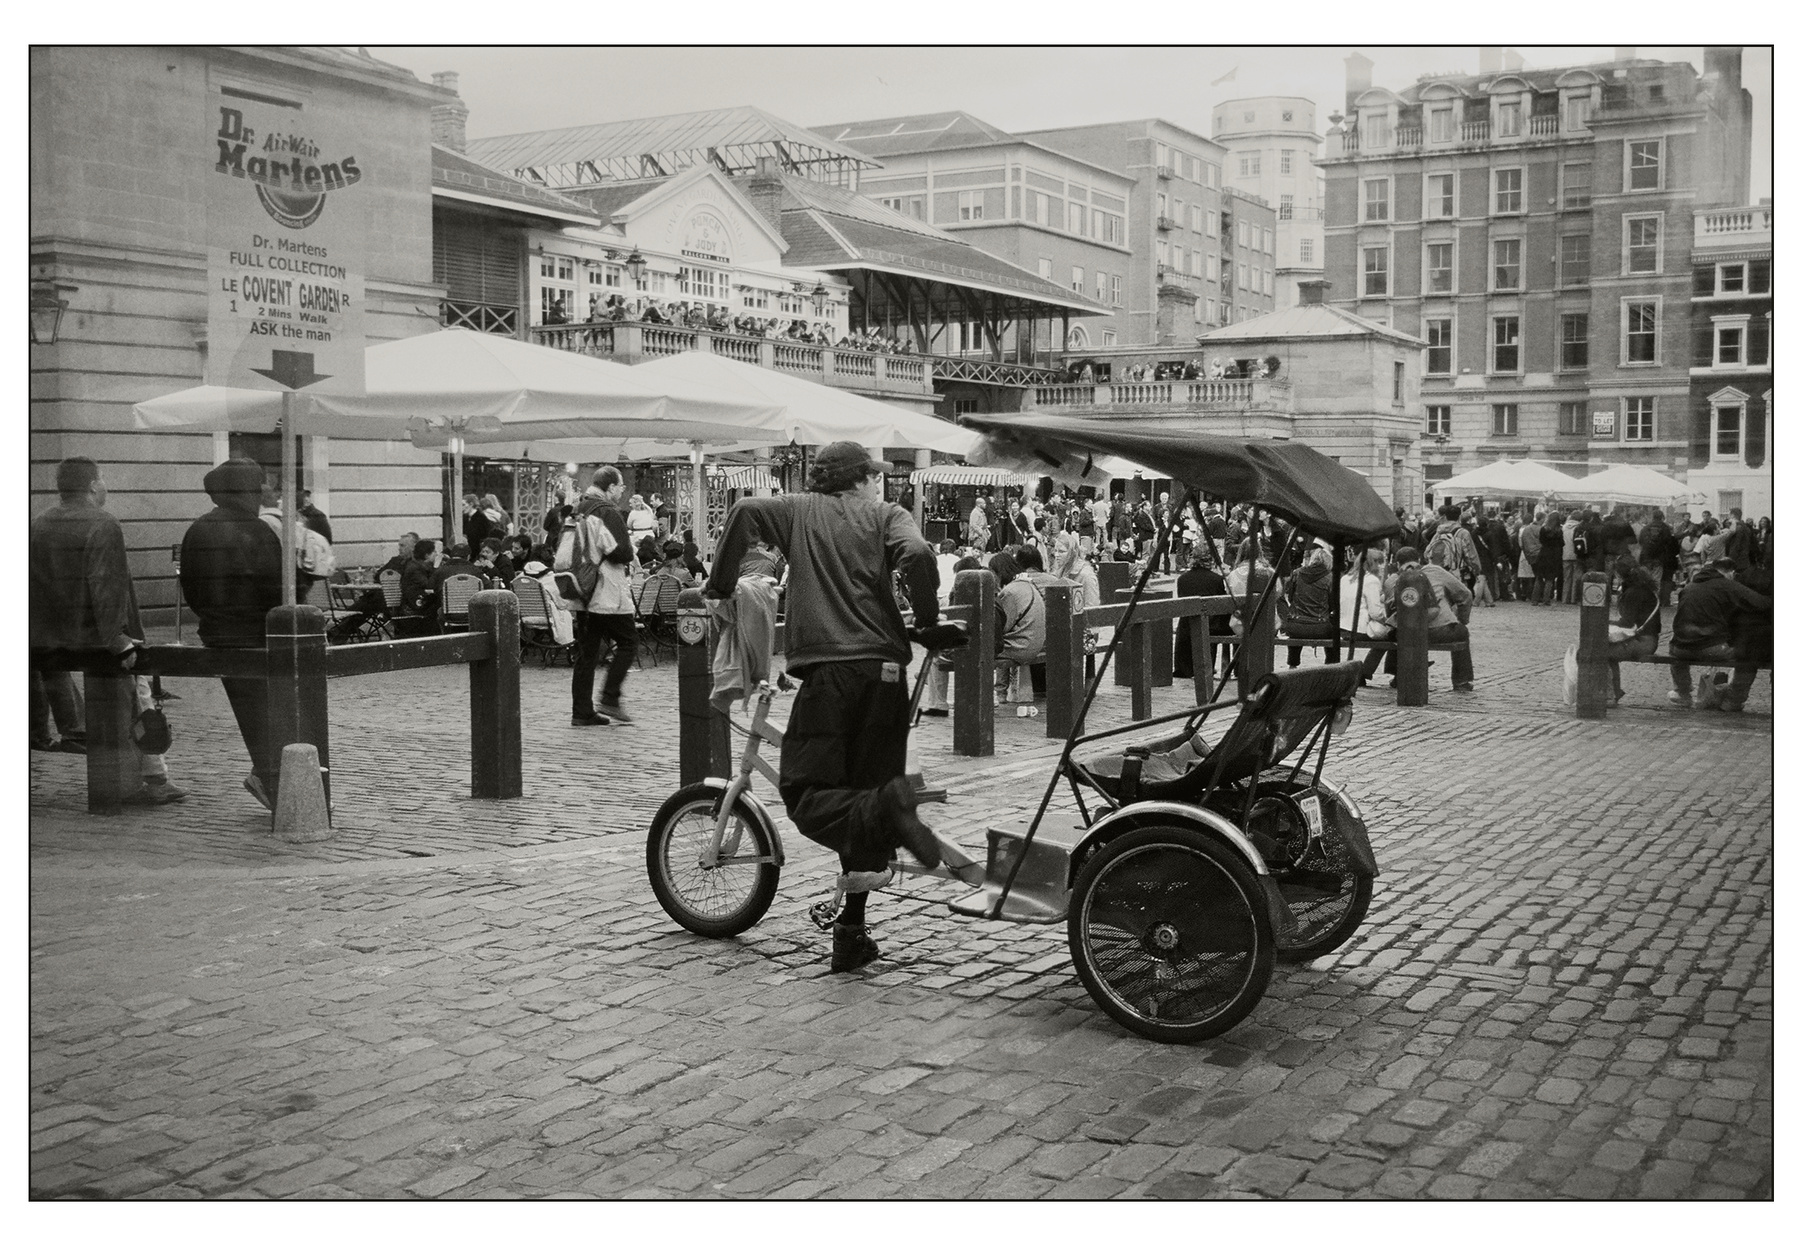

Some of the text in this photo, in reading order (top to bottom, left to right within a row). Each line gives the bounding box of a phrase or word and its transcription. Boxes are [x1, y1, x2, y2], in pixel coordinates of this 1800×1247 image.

[217, 105, 255, 144] Dr.
[262, 132, 321, 158] AirWair
[215, 139, 362, 193] Martens
[691, 215, 721, 235] PUNCH
[252, 234, 328, 258] Dr. Martens
[230, 251, 346, 280] FULL COLLECTION
[242, 275, 292, 306] COVENT
[299, 283, 341, 314] GARDEN
[258, 307, 328, 325] 2 Mins Walk
[250, 321, 331, 342] ASK the man
